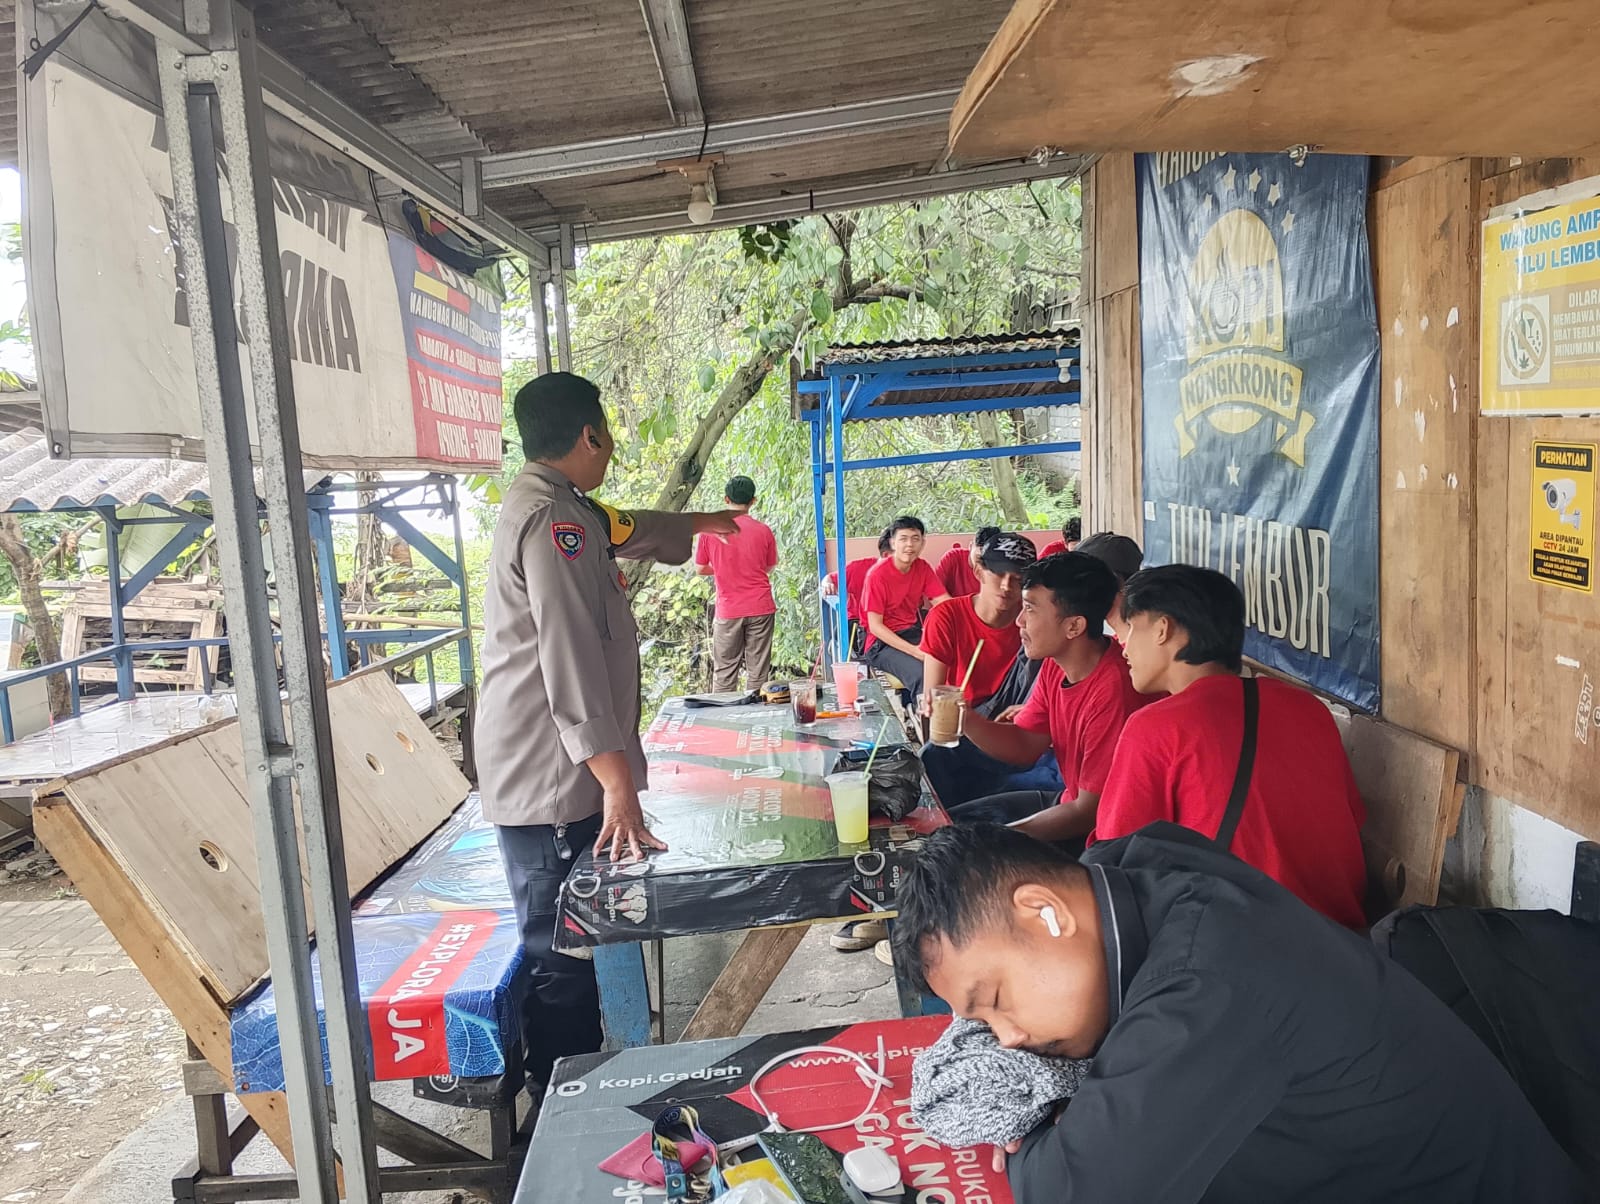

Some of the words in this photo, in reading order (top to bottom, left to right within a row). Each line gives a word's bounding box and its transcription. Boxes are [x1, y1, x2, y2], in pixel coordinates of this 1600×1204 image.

[1500, 219, 1562, 251] WARUNG
[1515, 252, 1546, 275] TILU
[1553, 309, 1594, 326] MEMBAWA
[1555, 341, 1594, 356] MINUMAN
[1184, 362, 1295, 407] NONGKRONG
[1540, 451, 1587, 467] PERHATIAN
[1540, 531, 1553, 541] AREA
[1556, 534, 1583, 546] DIPANTAU
[1543, 541, 1557, 550] CCTV
[1567, 545, 1579, 554] JAM
[600, 1065, 742, 1090] Kopi.Gadjah
